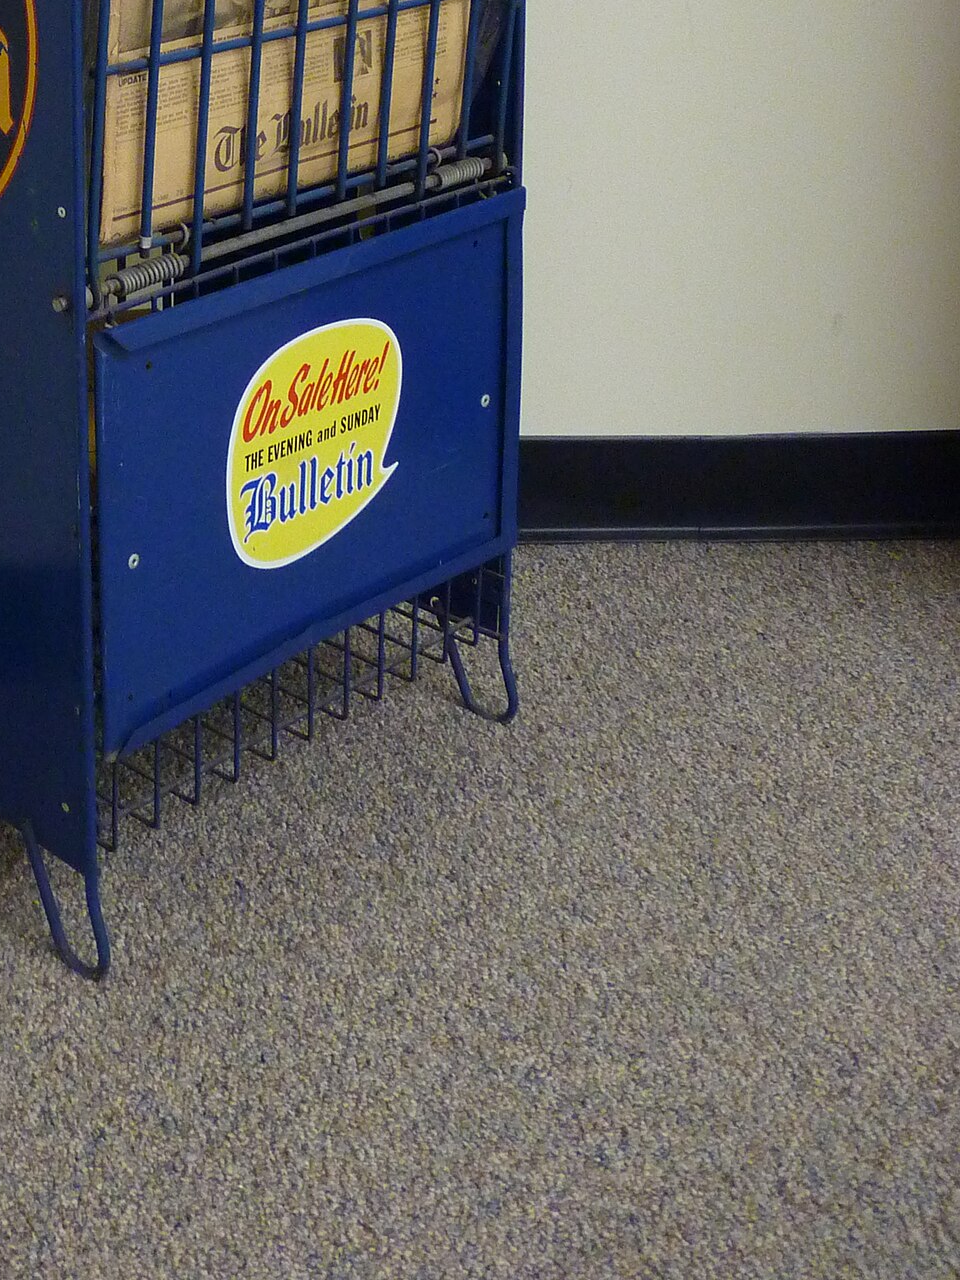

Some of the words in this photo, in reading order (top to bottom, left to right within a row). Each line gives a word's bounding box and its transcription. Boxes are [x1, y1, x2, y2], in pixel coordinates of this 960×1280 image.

[269, 94, 370, 158] Bullein
[242, 379, 282, 443] On
[280, 358, 333, 429] Sale
[331, 340, 390, 404] Here!
[245, 451, 264, 472] THE
[267, 430, 313, 463] EVENING
[316, 421, 337, 444] and
[340, 404, 381, 435] SUNDAY
[239, 442, 373, 544] Bulletin
